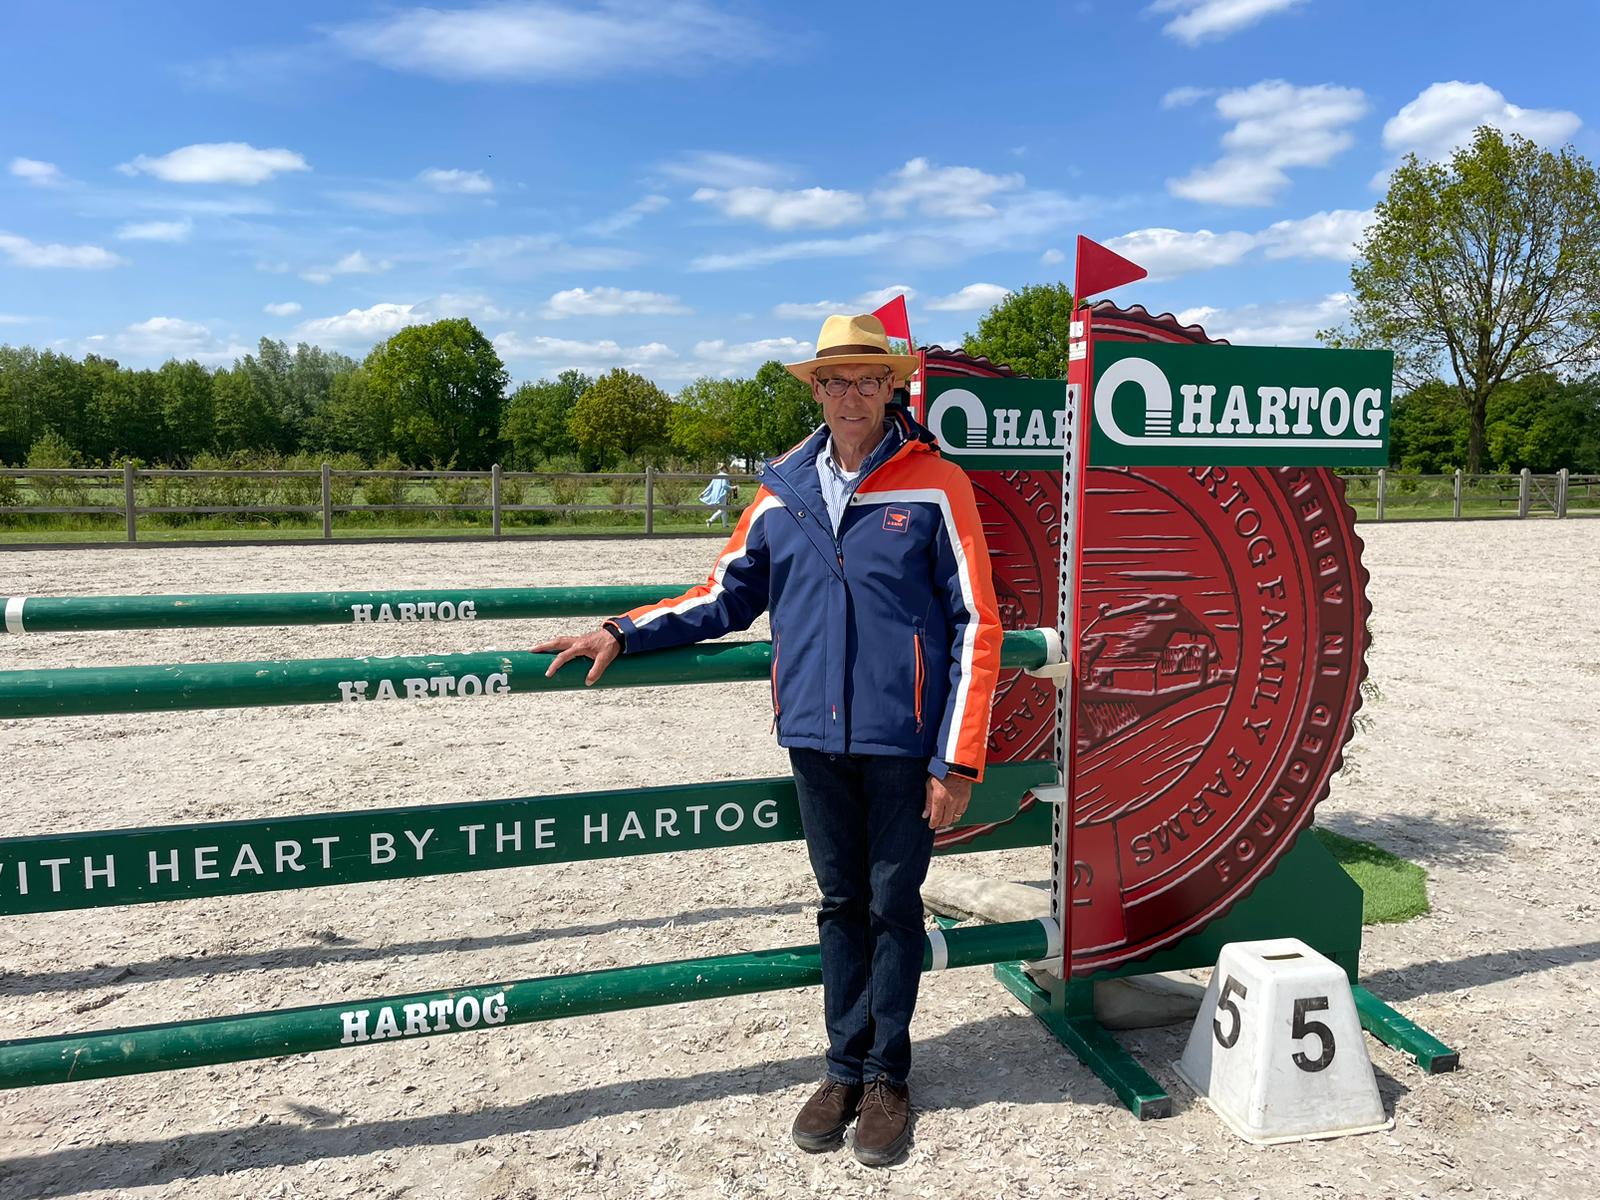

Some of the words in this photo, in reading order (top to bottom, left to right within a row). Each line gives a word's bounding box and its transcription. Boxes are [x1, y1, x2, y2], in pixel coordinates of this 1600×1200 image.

[1178, 385, 1384, 437] HARTOG
[1187, 466, 1276, 567] RTOG
[1280, 466, 1343, 604] ABBEK
[351, 601, 477, 623] HARTOG
[338, 673, 511, 702] HARTOG
[1243, 575, 1288, 745] FAMILY
[1320, 634, 1344, 676] IN
[1130, 747, 1251, 866] FARMS
[1213, 705, 1331, 882] FOUNDED
[0, 855, 115, 895] ITH
[148, 836, 340, 883] HEART
[370, 828, 434, 865] BY
[459, 818, 556, 855] THE
[584, 800, 778, 844] HARTOG
[340, 992, 508, 1044] HARTOG
[1213, 974, 1248, 1049] 5
[1292, 996, 1335, 1073] 5
